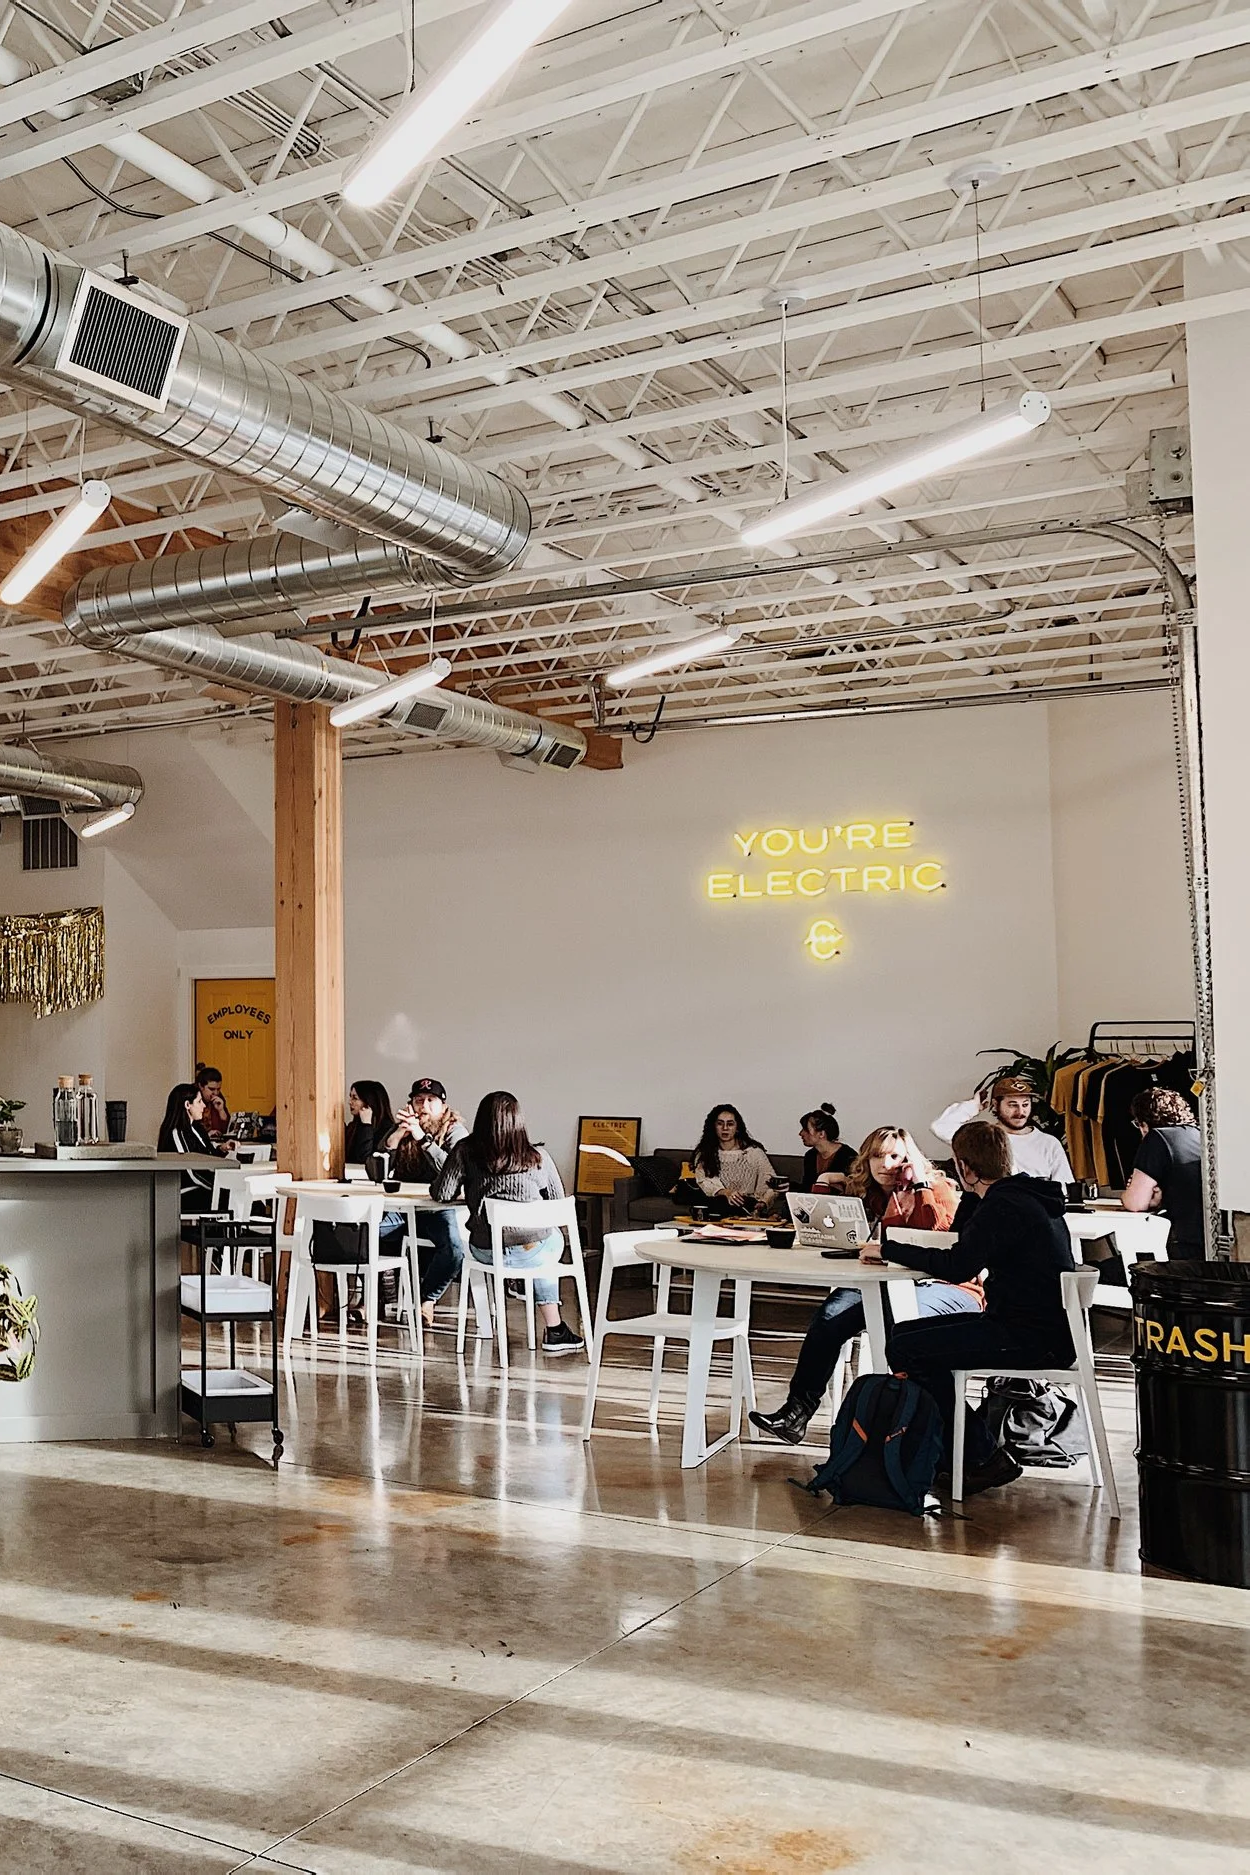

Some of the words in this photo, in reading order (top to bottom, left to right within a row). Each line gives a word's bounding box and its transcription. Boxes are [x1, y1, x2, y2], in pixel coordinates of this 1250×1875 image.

[733, 821, 913, 857] YOU'RE
[707, 862, 946, 899] ELECTRIC
[207, 1004, 271, 1025] EMPLOYEES
[223, 1030, 254, 1040] ONLY
[592, 1121, 627, 1129] ELECTRIC
[1134, 1316, 1250, 1364] TRASH
